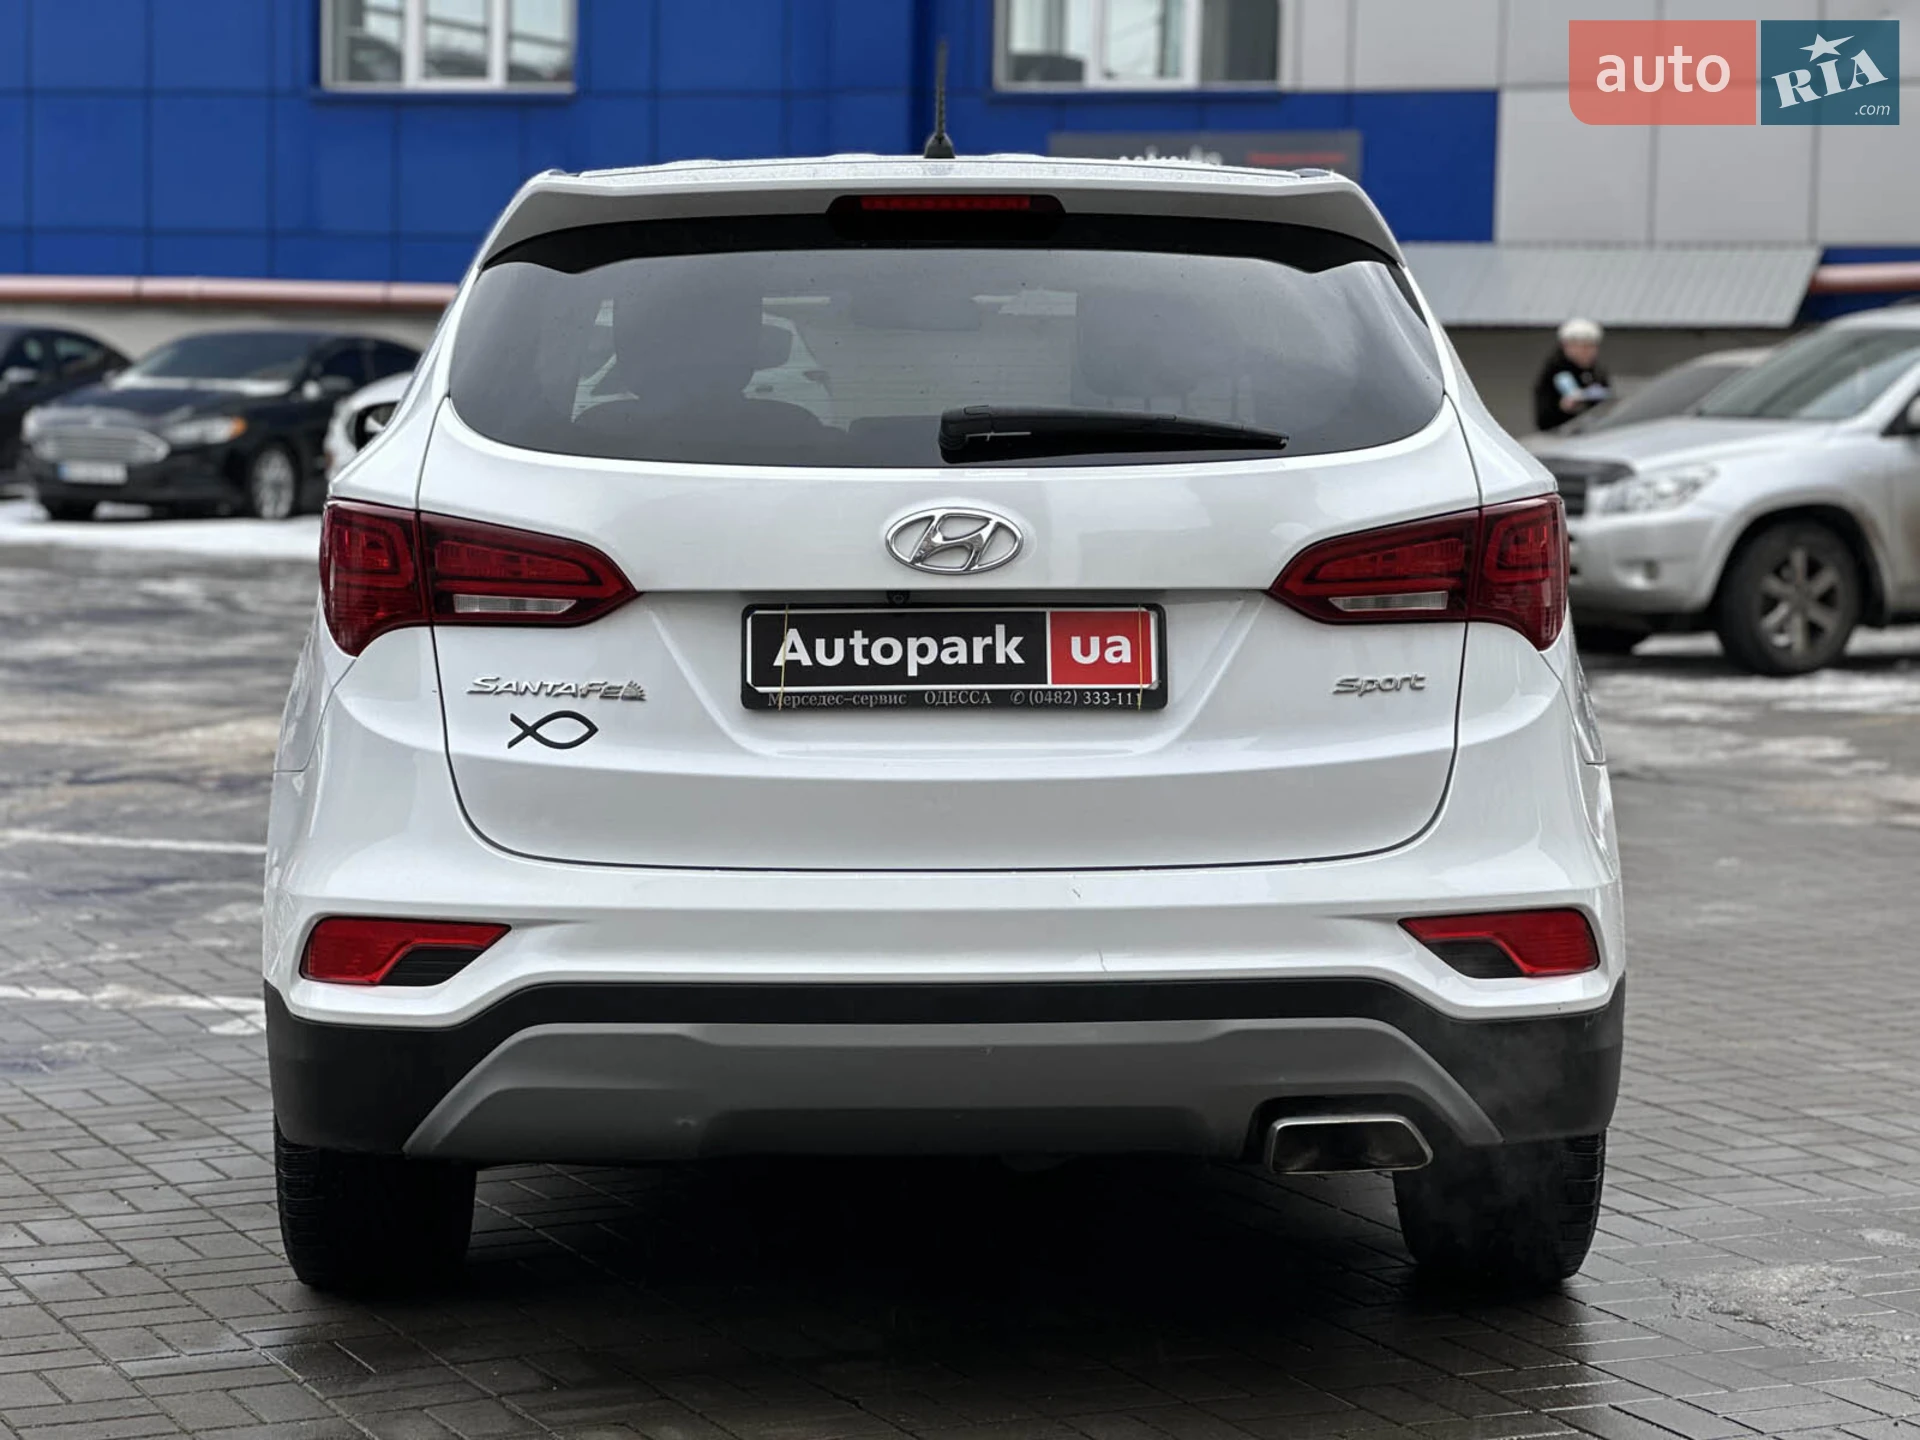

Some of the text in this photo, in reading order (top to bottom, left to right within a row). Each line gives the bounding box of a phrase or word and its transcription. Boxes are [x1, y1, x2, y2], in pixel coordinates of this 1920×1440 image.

[772, 624, 1132, 677] Autopark ua
[1332, 673, 1426, 697] Sport
[924, 690, 992, 706] ОДЕССА
[1029, 690, 1078, 706] (0482)
